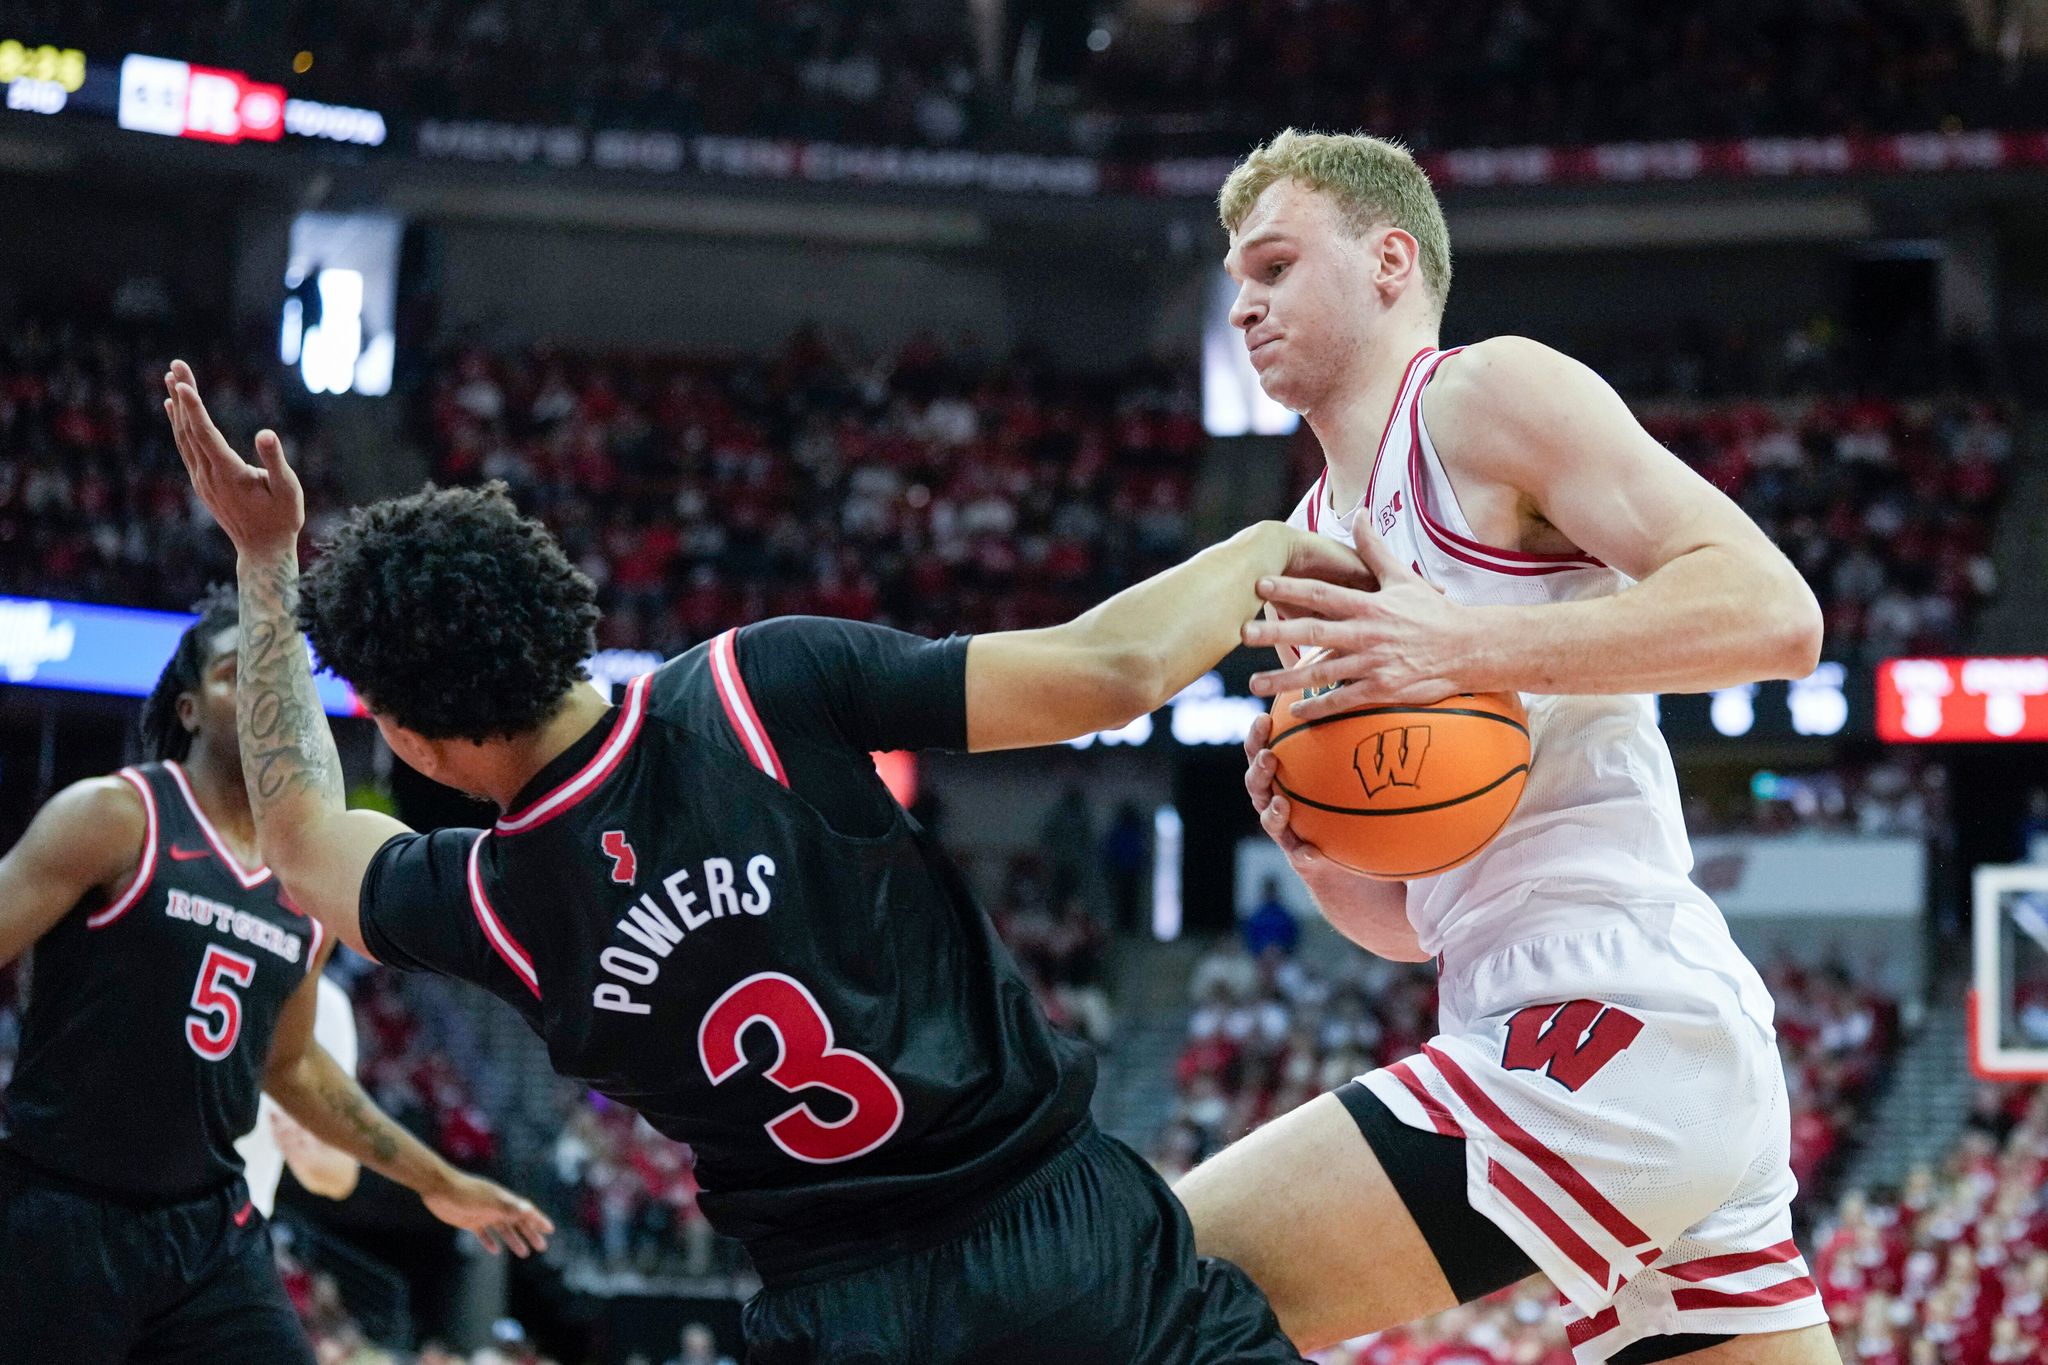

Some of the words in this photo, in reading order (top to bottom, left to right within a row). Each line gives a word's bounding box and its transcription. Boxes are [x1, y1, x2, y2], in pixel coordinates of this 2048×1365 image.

[1353, 725, 1431, 800] W
[165, 888, 301, 963] RUTGERS
[593, 854, 776, 1015] POWERS
[185, 942, 257, 1062] 5
[1501, 998, 1645, 1093] W
[698, 971, 904, 1165] 3
